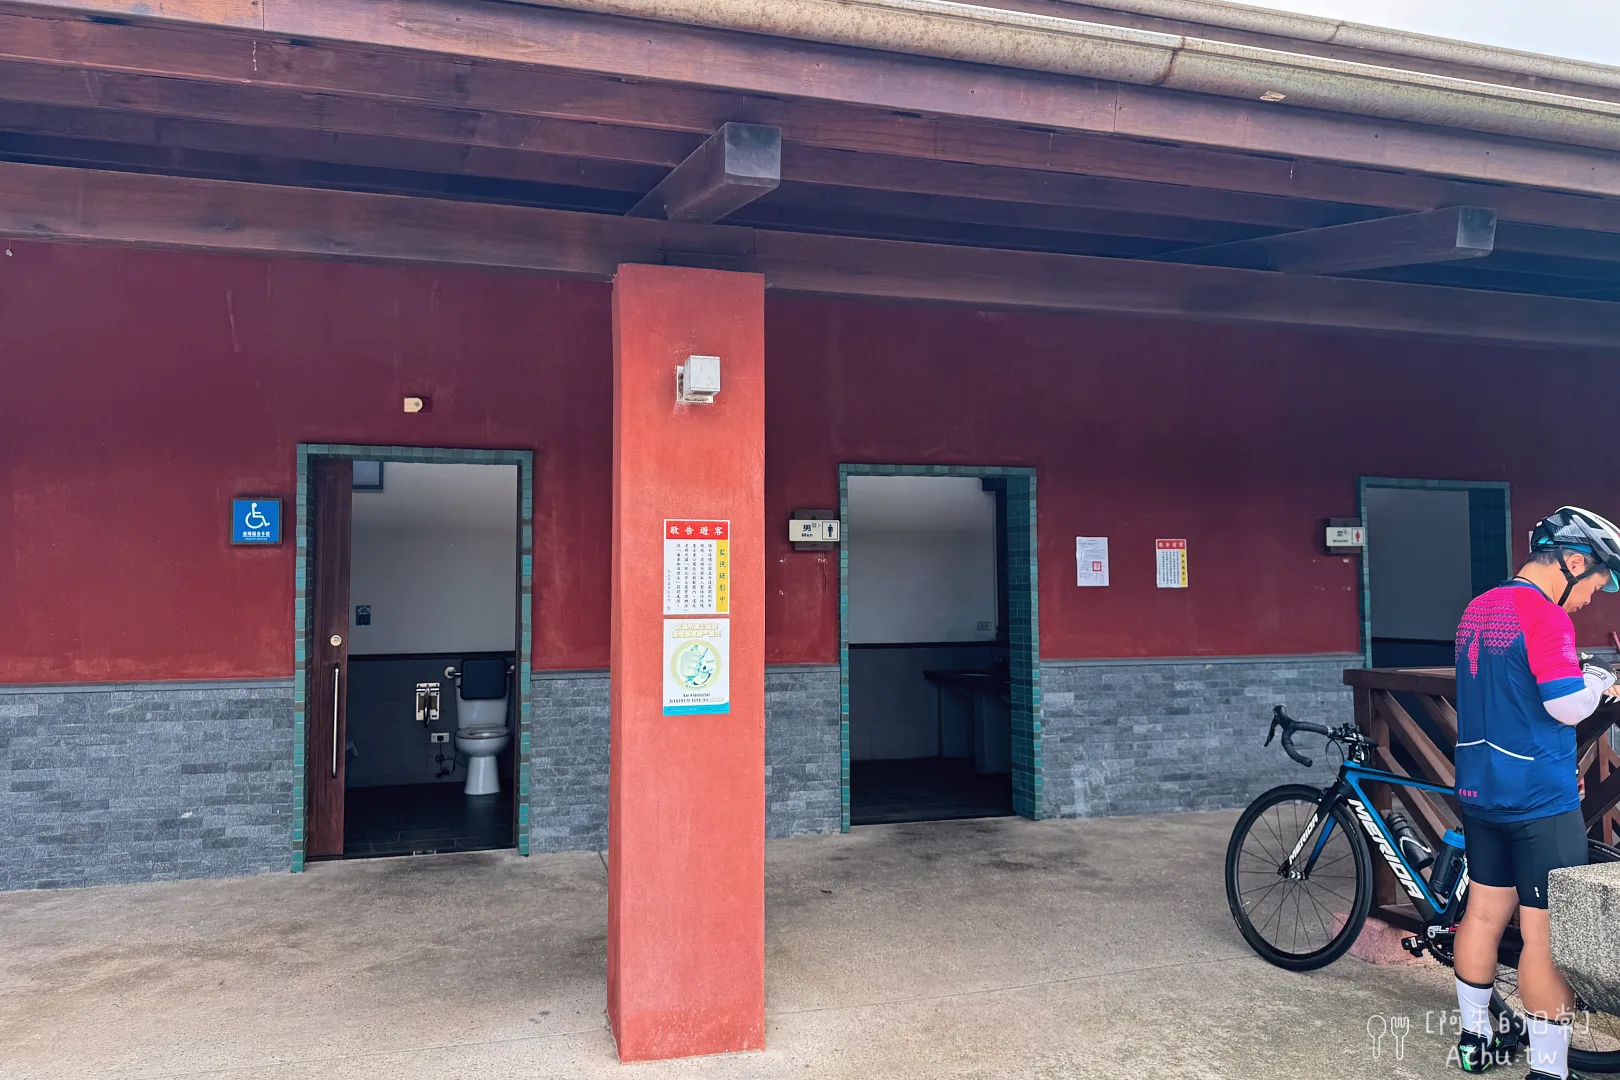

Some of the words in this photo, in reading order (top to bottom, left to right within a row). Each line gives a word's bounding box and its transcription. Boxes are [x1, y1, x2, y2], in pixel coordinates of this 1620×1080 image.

[669, 525, 724, 536] 敬告遊客
[803, 524, 812, 532] 男
[719, 548, 727, 603] 監視錄影中
[1288, 812, 1318, 866] MERIDA
[1347, 798, 1424, 900] MERIDA
